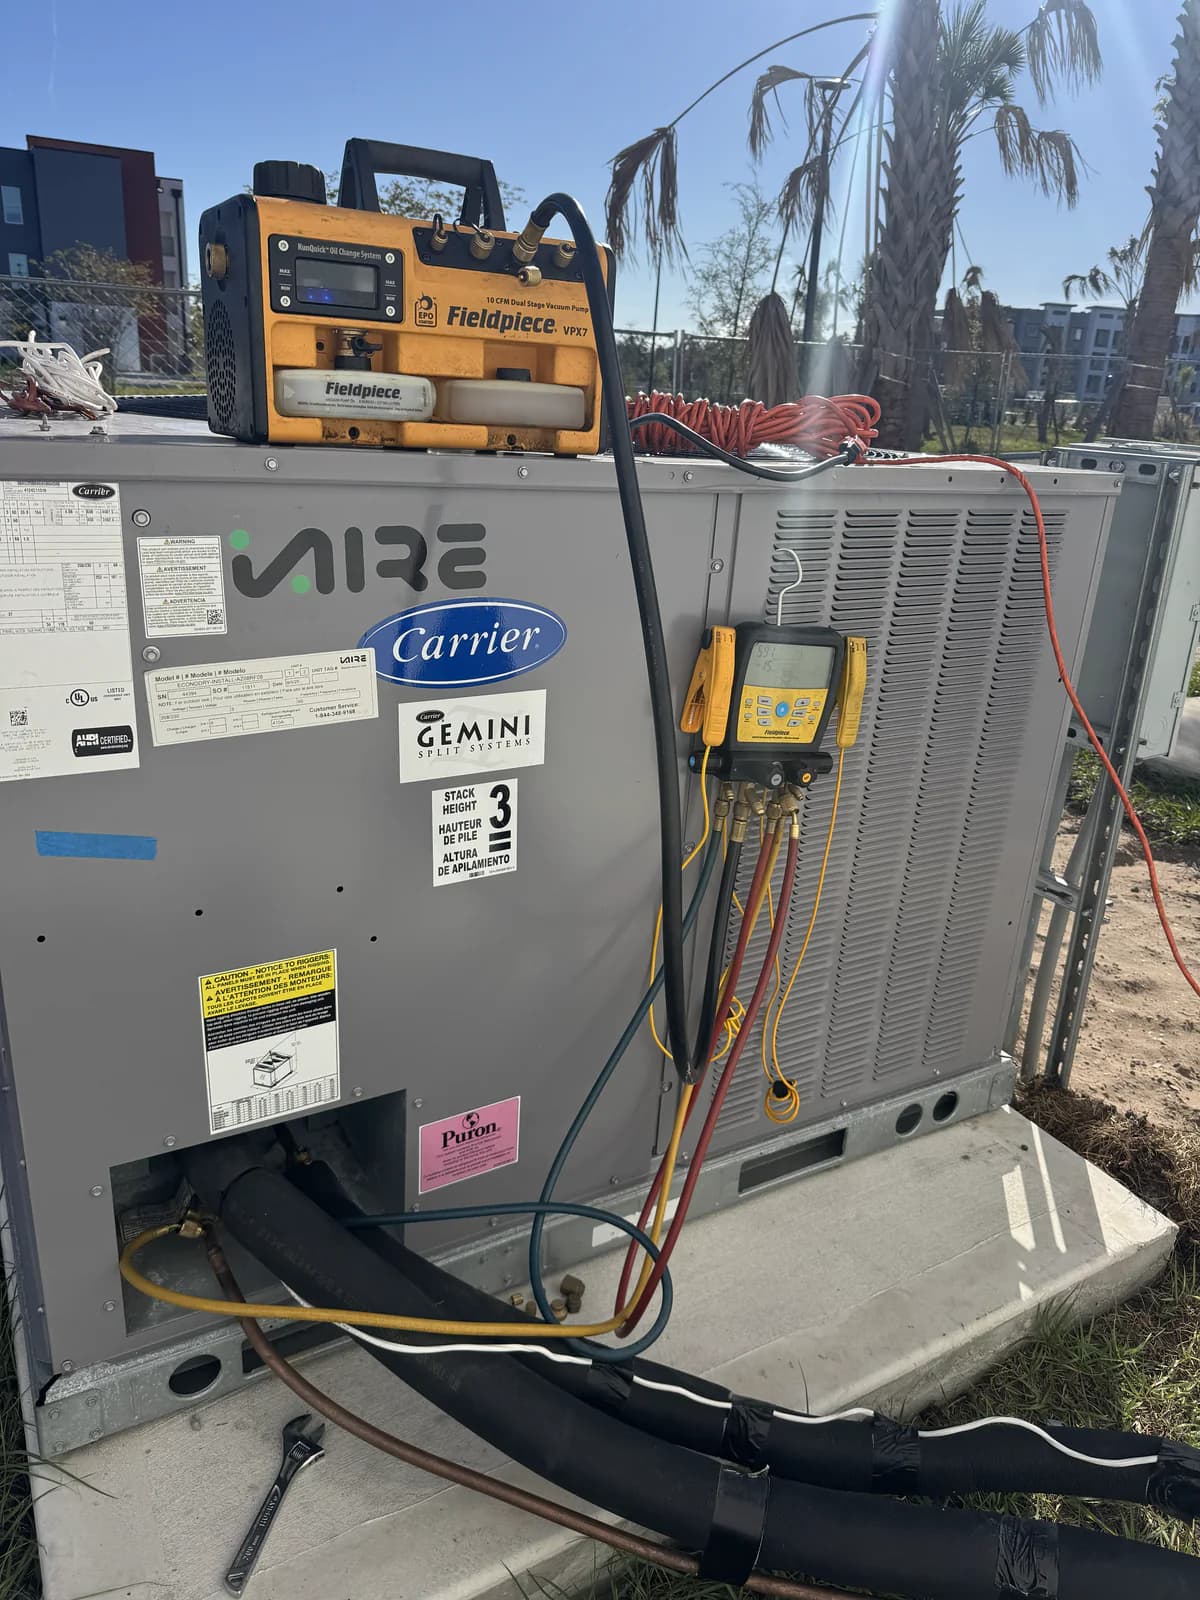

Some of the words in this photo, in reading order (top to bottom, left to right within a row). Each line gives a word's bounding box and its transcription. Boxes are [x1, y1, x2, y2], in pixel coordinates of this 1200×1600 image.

[329, 247, 338, 255] Oil
[338, 248, 360, 259] Change
[361, 251, 381, 260] System
[495, 297, 510, 305] CFM
[511, 298, 526, 307] Dual
[527, 300, 545, 309] Stage
[546, 302, 570, 311] Vacuum
[571, 304, 589, 313] Pump
[418, 311, 434, 320] EPO
[446, 305, 557, 334] Fieldpiece
[563, 326, 588, 337] VPX7
[325, 382, 401, 399] Fieldpiece
[78, 487, 111, 496] Carrier
[392, 622, 541, 663] Carrier
[74, 692, 85, 703] UL
[309, 704, 337, 713] Customer
[419, 712, 441, 720] Carrier
[416, 715, 530, 748] GEMINI
[100, 735, 128, 745] CERTIFIED
[418, 746, 461, 759] SPLIT
[470, 737, 531, 753] SYSTEMS
[444, 788, 475, 802] STACK
[442, 800, 477, 815] HEIGHT
[489, 784, 511, 829] 3
[438, 818, 482, 834] HAUTEUR
[443, 834, 456, 845] DE
[458, 830, 478, 843] PILE
[442, 848, 478, 863] ALTURA
[438, 866, 450, 877] DE
[451, 854, 510, 874] APILAMIENTO
[214, 971, 249, 983] CAUTION
[255, 963, 283, 974] NOTICE
[285, 960, 295, 968] TO
[217, 979, 239, 988] PANELS
[240, 975, 256, 983] MUST
[272, 968, 289, 976] PLACE
[215, 976, 281, 996] AVERTISSEMENT
[288, 965, 332, 980] REMARQUE
[207, 1003, 223, 1011] TOUS
[234, 995, 257, 1005] CAPOTS
[258, 990, 281, 999] DOIVENT
[305, 981, 322, 989] PLACE
[222, 986, 272, 1001] L'ATTENTION
[273, 982, 288, 990] DES
[207, 1008, 223, 1016] AVANT
[441, 1122, 497, 1149] Puron
